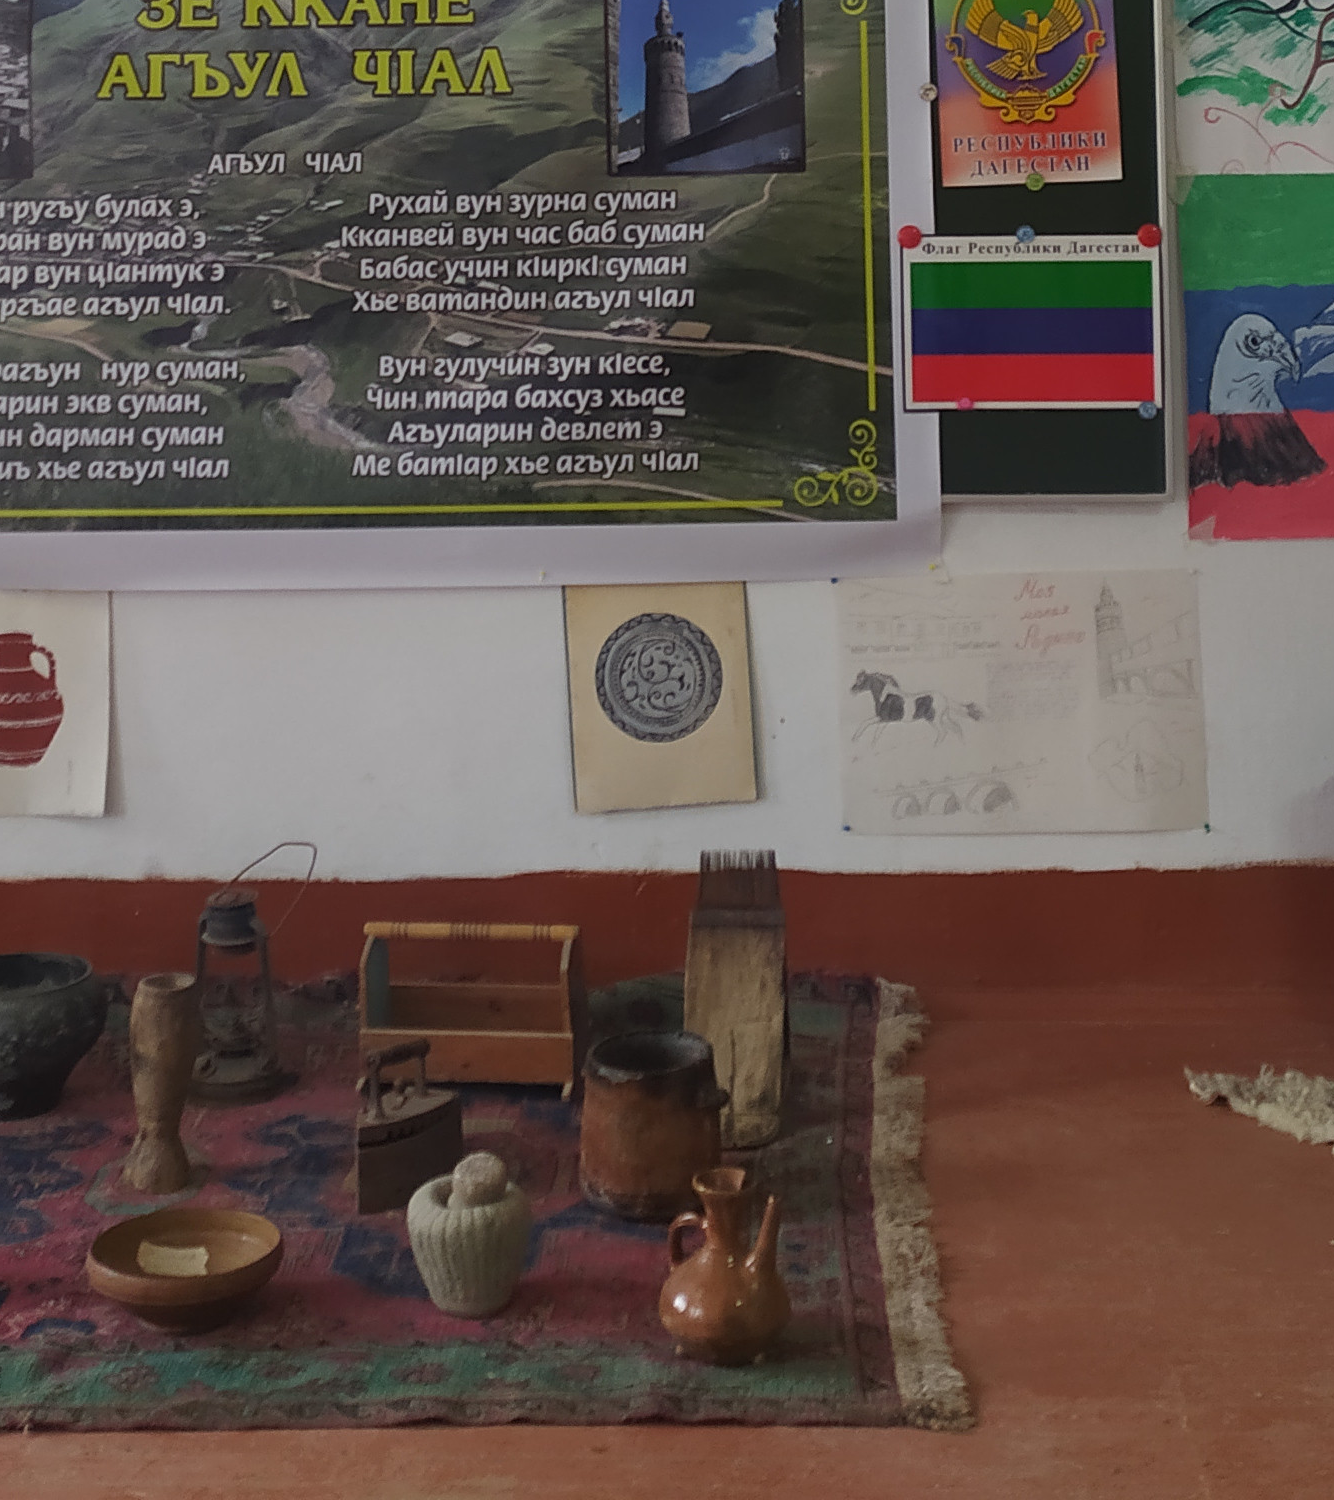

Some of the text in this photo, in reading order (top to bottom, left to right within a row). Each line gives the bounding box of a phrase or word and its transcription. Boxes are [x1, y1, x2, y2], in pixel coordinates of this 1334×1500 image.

[96, 51, 309, 99] АГЪУЛ
[953, 131, 1108, 154] РЕСПУБЛИКИ
[208, 153, 285, 176] АГЪУЛ
[970, 156, 1091, 177] ДАГЕСТАН
[13, 199, 89, 225] ругъу
[95, 194, 172, 223] булах
[369, 190, 676, 220] Рухай вун зурна суман
[48, 233, 93, 256] вун
[101, 226, 186, 256] мурад
[342, 220, 705, 251] Кканвей вун час баб суман
[921, 240, 1141, 258] Флаг Республики Дагестан
[34, 265, 80, 289] вун
[360, 256, 438, 279] Бабас
[444, 258, 508, 284] учин
[605, 255, 687, 283] суман
[83, 295, 159, 321] агъул
[353, 290, 397, 312] Хье
[406, 286, 546, 311] ватандин
[554, 289, 630, 315] агъул
[101, 361, 149, 386] нур
[156, 359, 246, 388] суман,
[379, 355, 426, 383] Вун
[433, 355, 540, 383] гулучин
[547, 355, 590, 381] зун
[65, 394, 111, 414] экв
[118, 392, 208, 419] суман,
[367, 383, 684, 414] Чин ппара бахсуз хьасе
[29, 422, 134, 452] дарман
[141, 425, 223, 451] суман
[388, 416, 662, 447] Агъуларин девлет э
[37, 461, 80, 480] хье
[87, 459, 165, 486] агъул
[353, 454, 390, 477] Ме
[504, 455, 548, 474] хье
[556, 452, 633, 478] агъул
